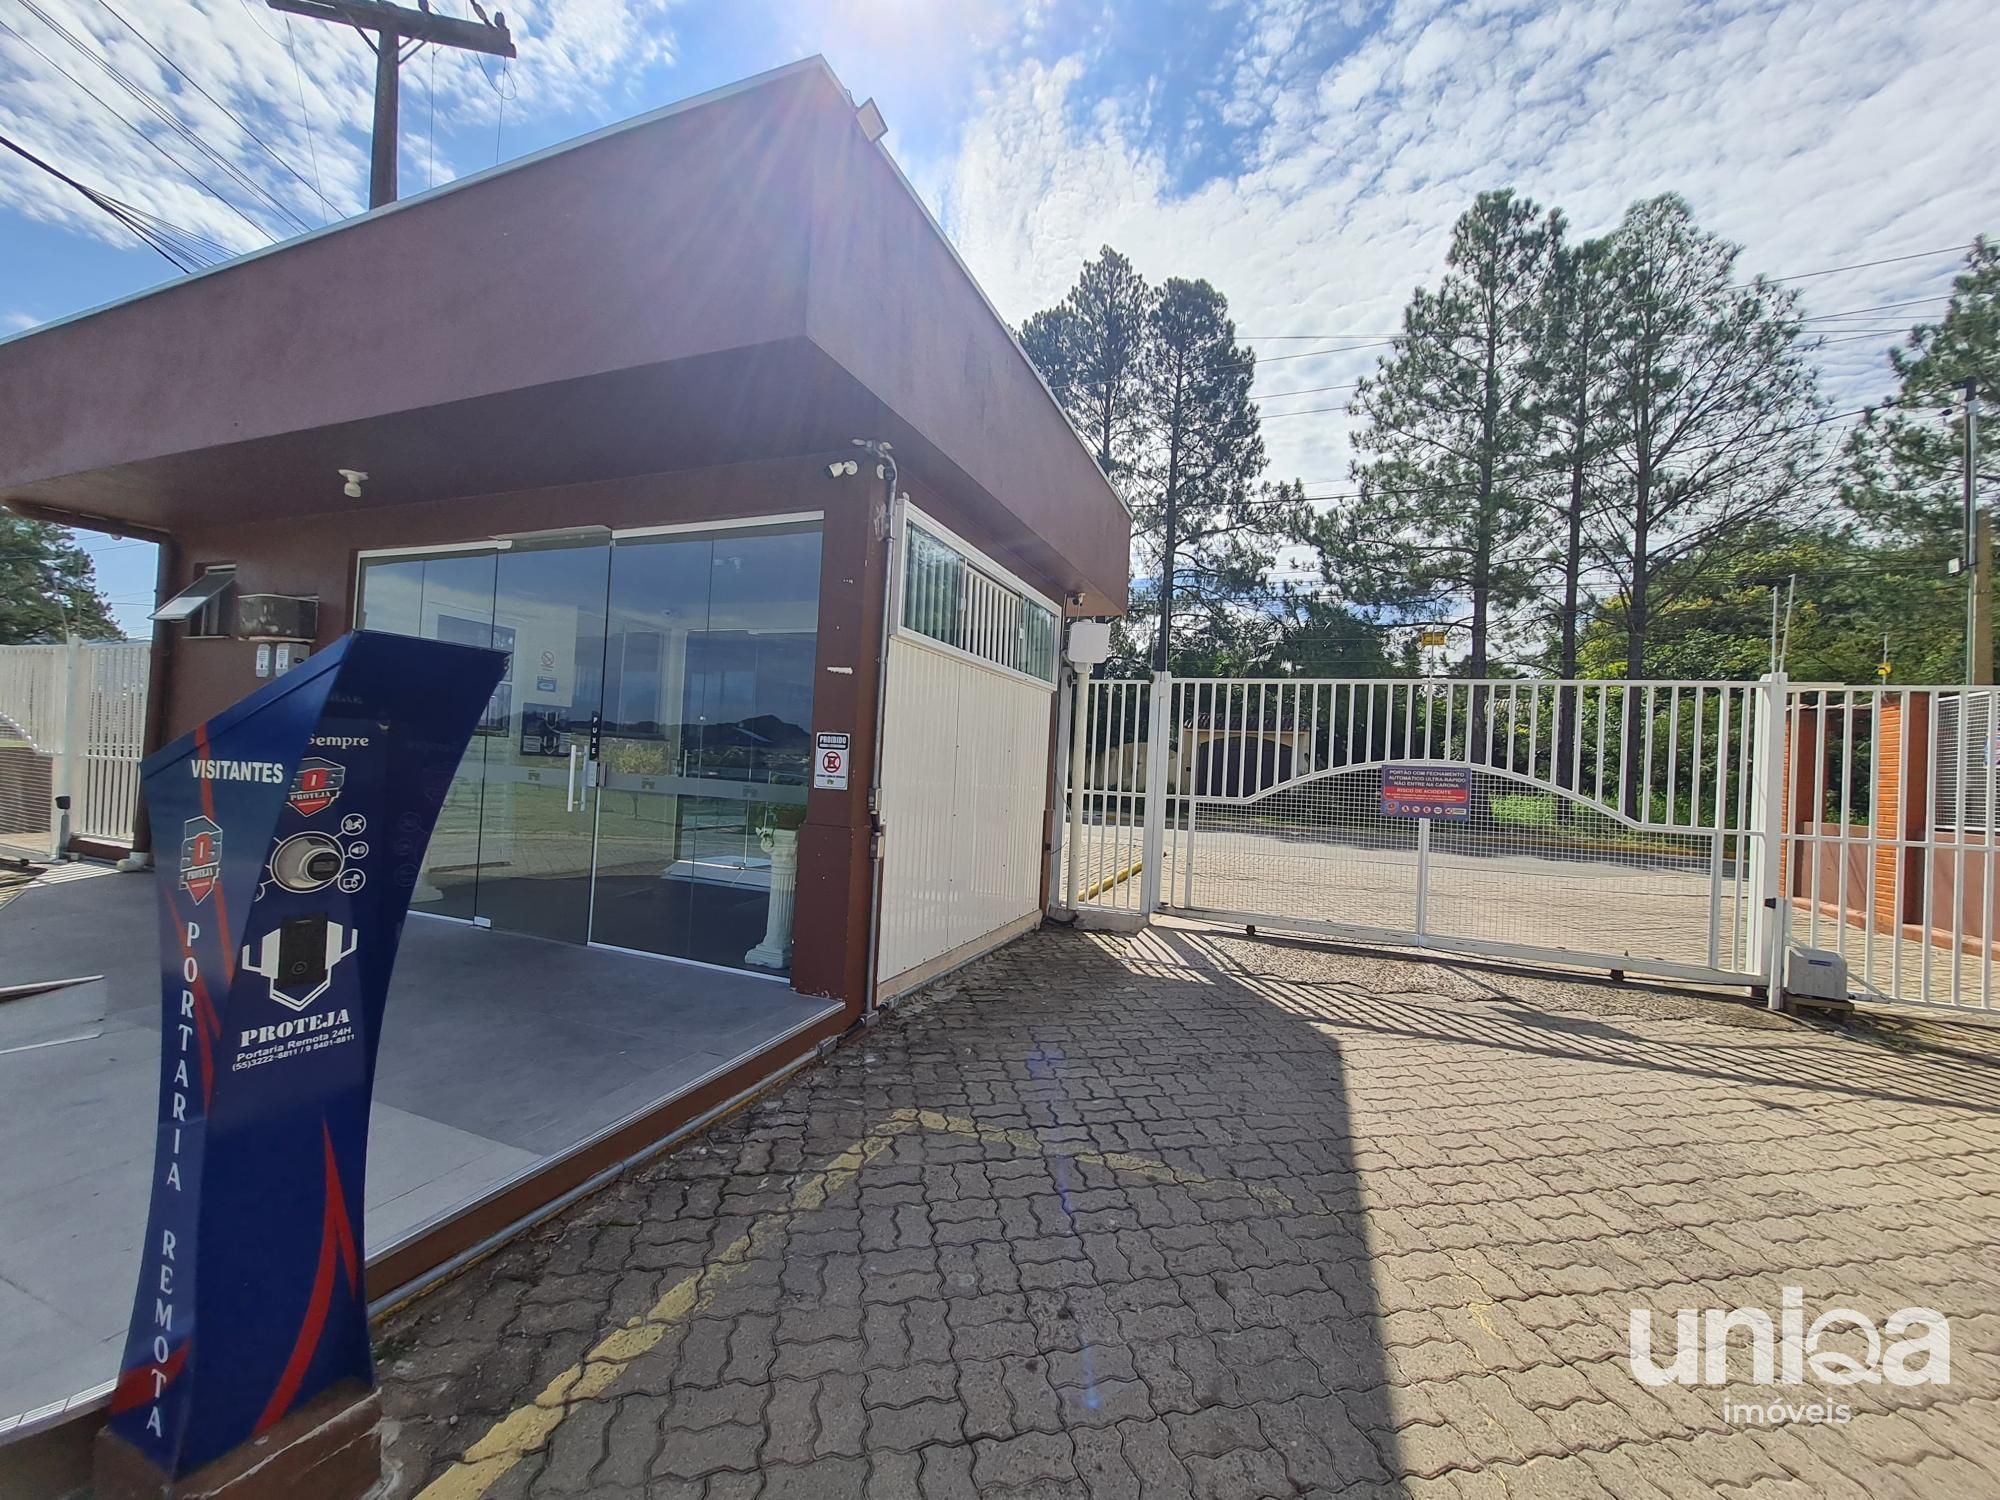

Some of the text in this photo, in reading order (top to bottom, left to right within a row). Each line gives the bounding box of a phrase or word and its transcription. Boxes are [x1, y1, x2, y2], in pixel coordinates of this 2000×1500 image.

[191, 759, 284, 784] VISITANTES
[290, 791, 331, 801] PROTEJA
[236, 1026, 352, 1062] Portaria Remota 24H
[240, 1009, 350, 1047] PROTEJA
[146, 921, 200, 1437] PORTARIA REMOTA
